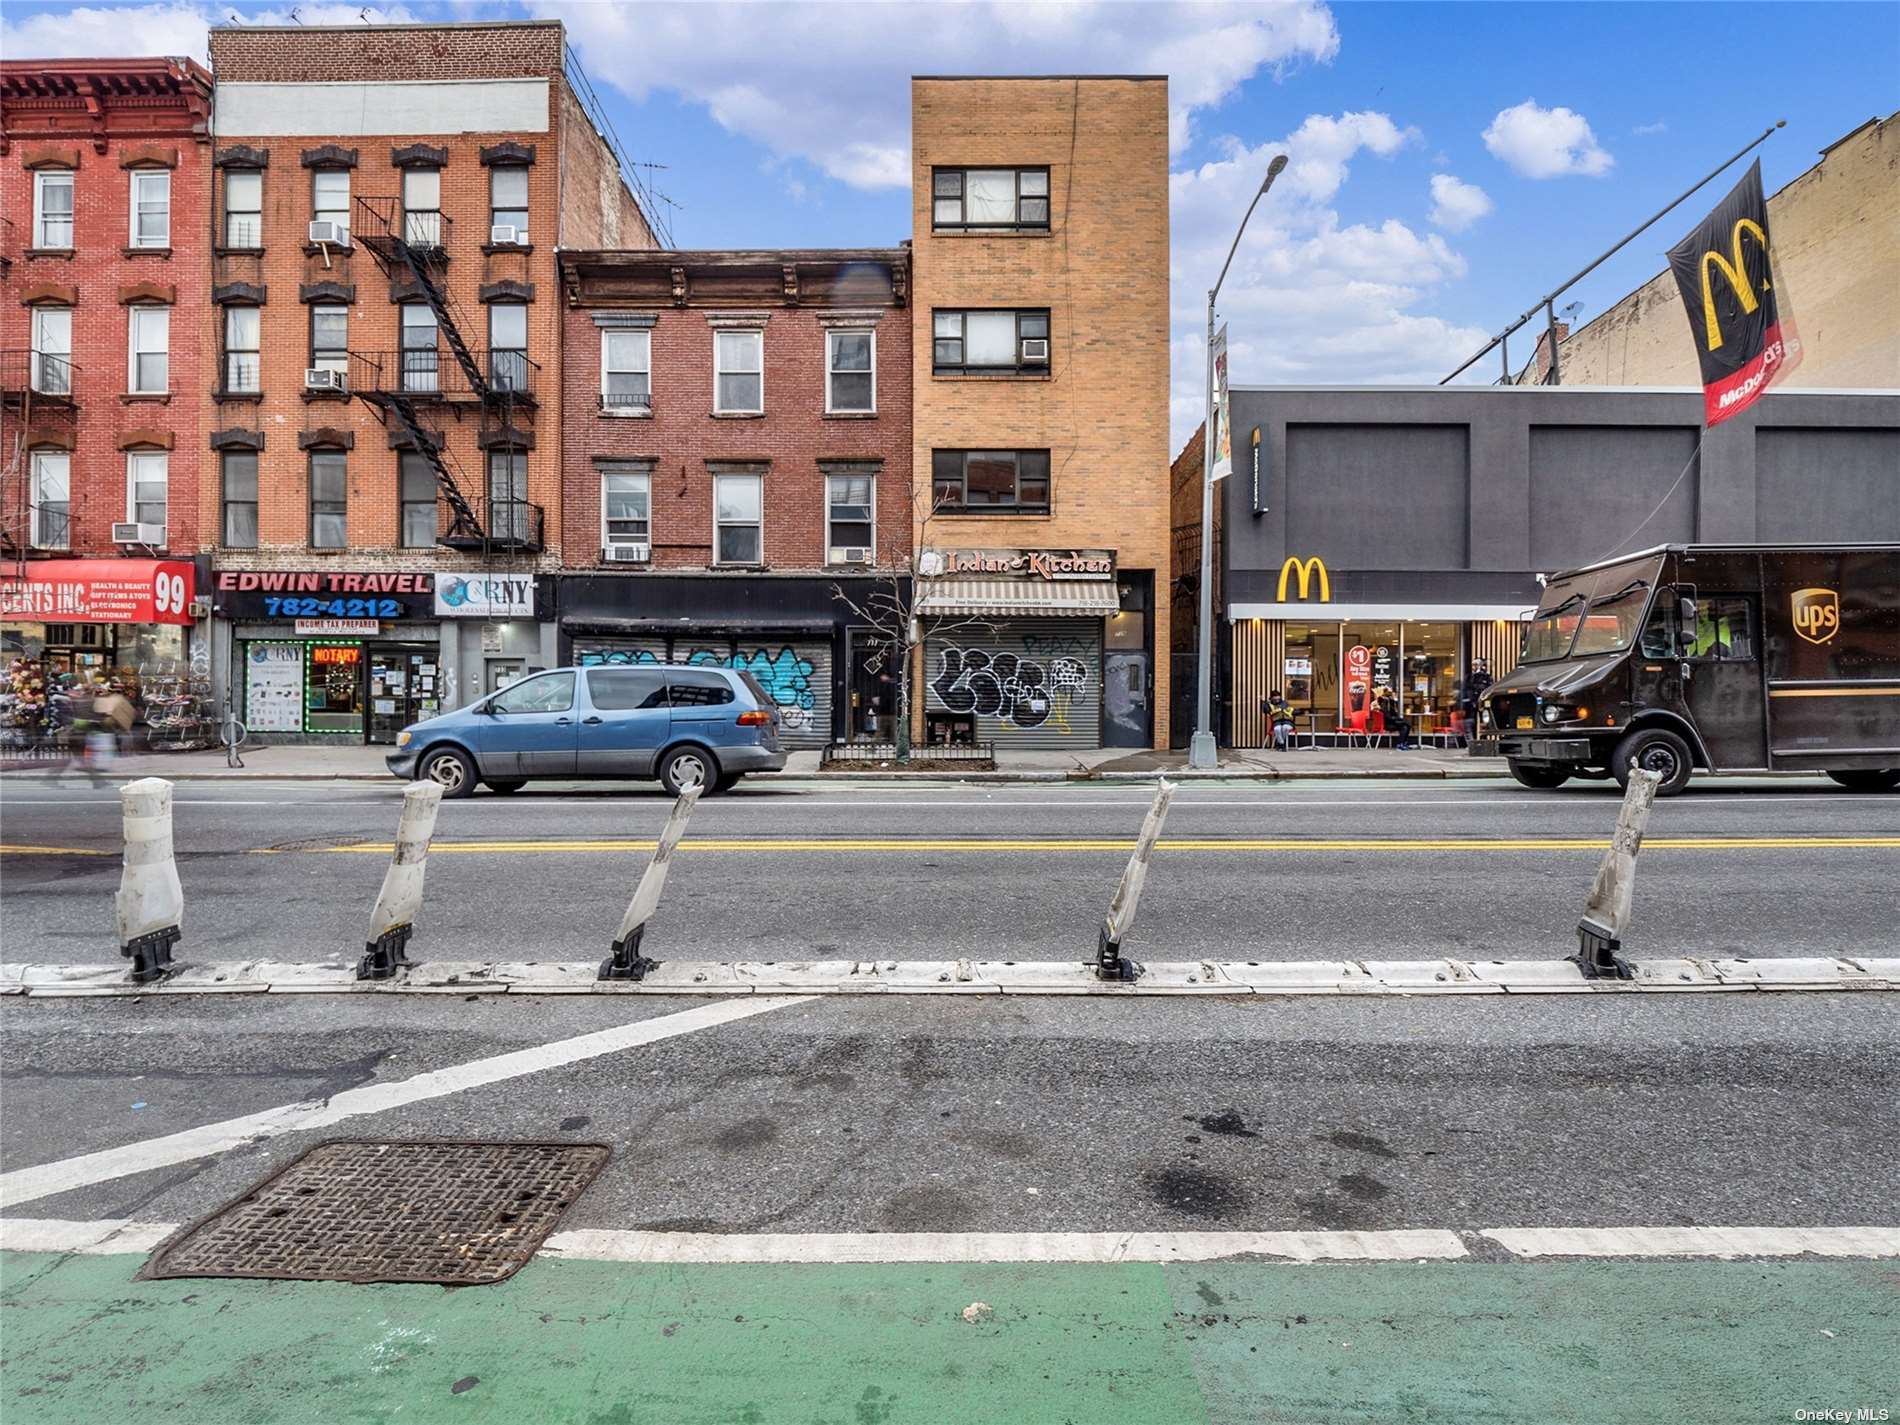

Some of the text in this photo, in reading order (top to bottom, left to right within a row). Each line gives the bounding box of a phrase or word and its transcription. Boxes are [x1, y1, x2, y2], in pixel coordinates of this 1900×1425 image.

[945, 551, 1010, 573] Indian
[1027, 551, 1112, 580] Kitchen
[155, 571, 185, 615] 99
[220, 572, 432, 592] EDWIN TRAVEL
[1, 582, 90, 615] CENTS INC.
[265, 597, 400, 617] 782-4212
[298, 620, 377, 628] INCOME TAX PREPARER
[1795, 605, 1837, 636] ups
[314, 648, 359, 662] NOTARY
